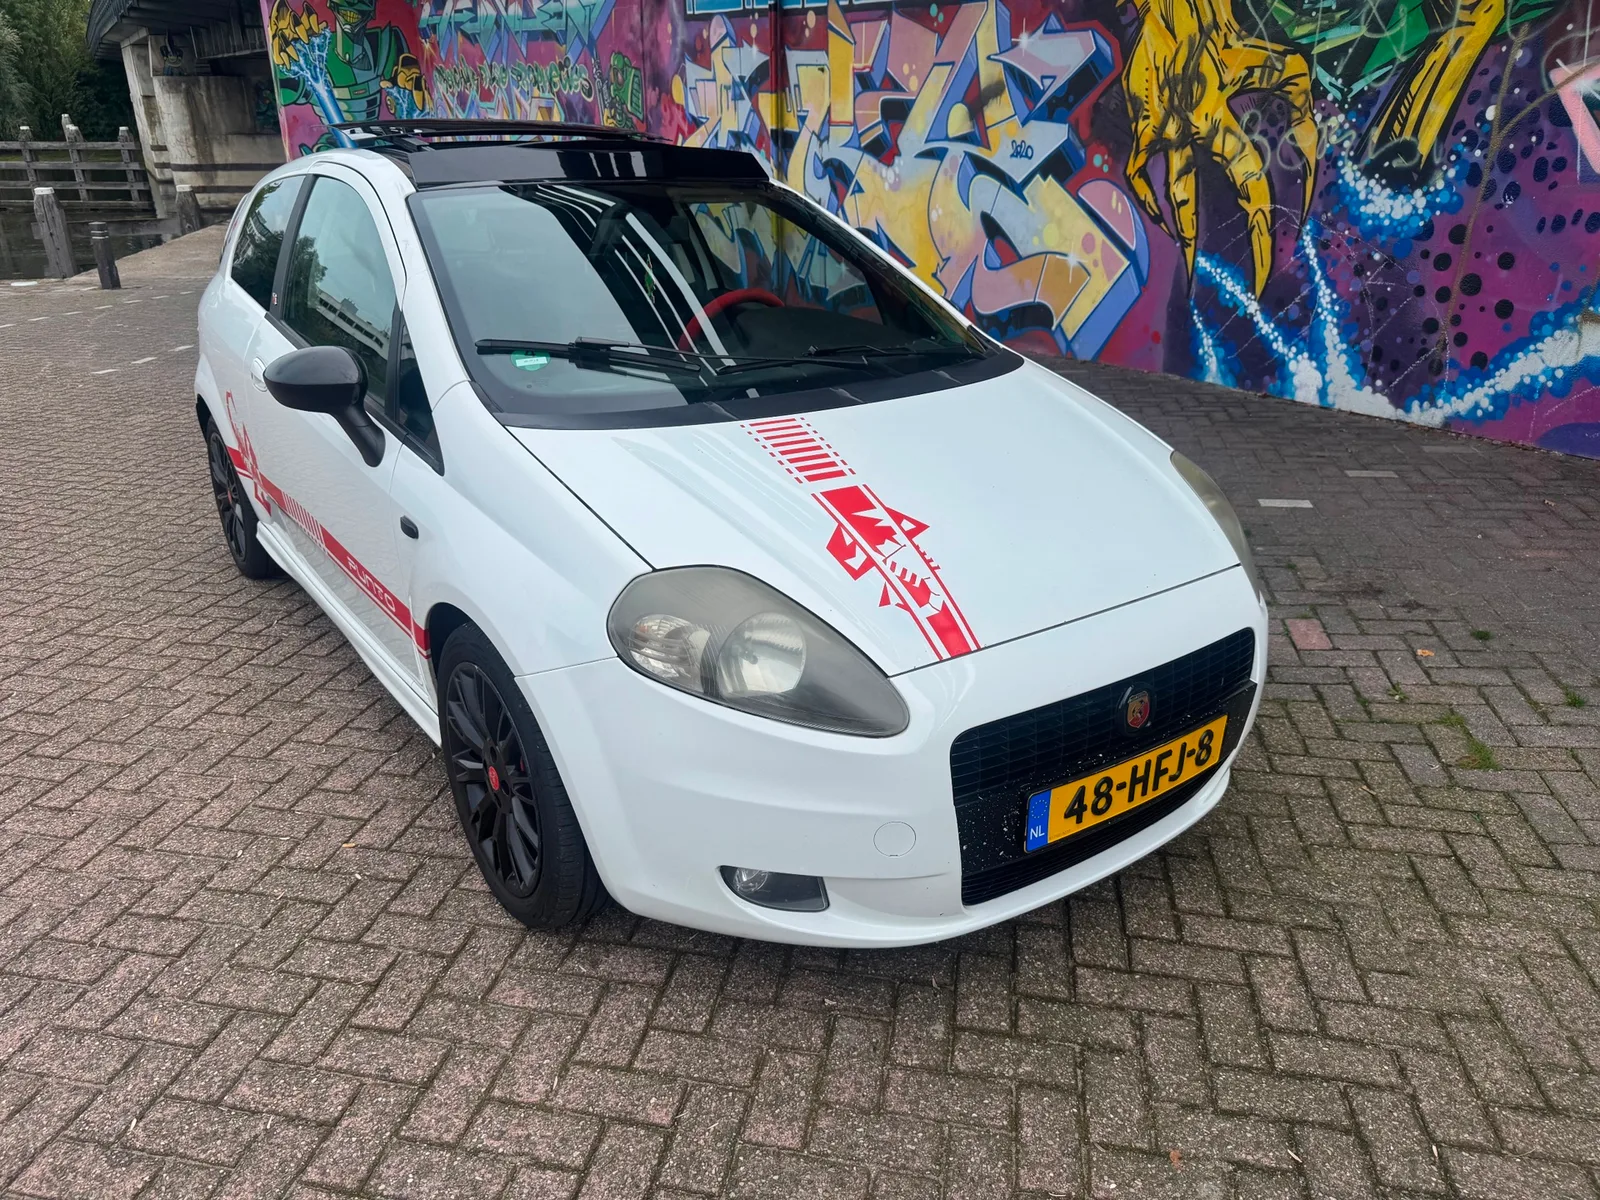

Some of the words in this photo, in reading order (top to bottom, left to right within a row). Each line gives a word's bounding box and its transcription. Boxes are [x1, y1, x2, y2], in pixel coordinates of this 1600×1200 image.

[347, 556, 395, 612] PUNTO
[1063, 729, 1214, 824] 48-HFJ-8
[1030, 825, 1045, 840] NL
